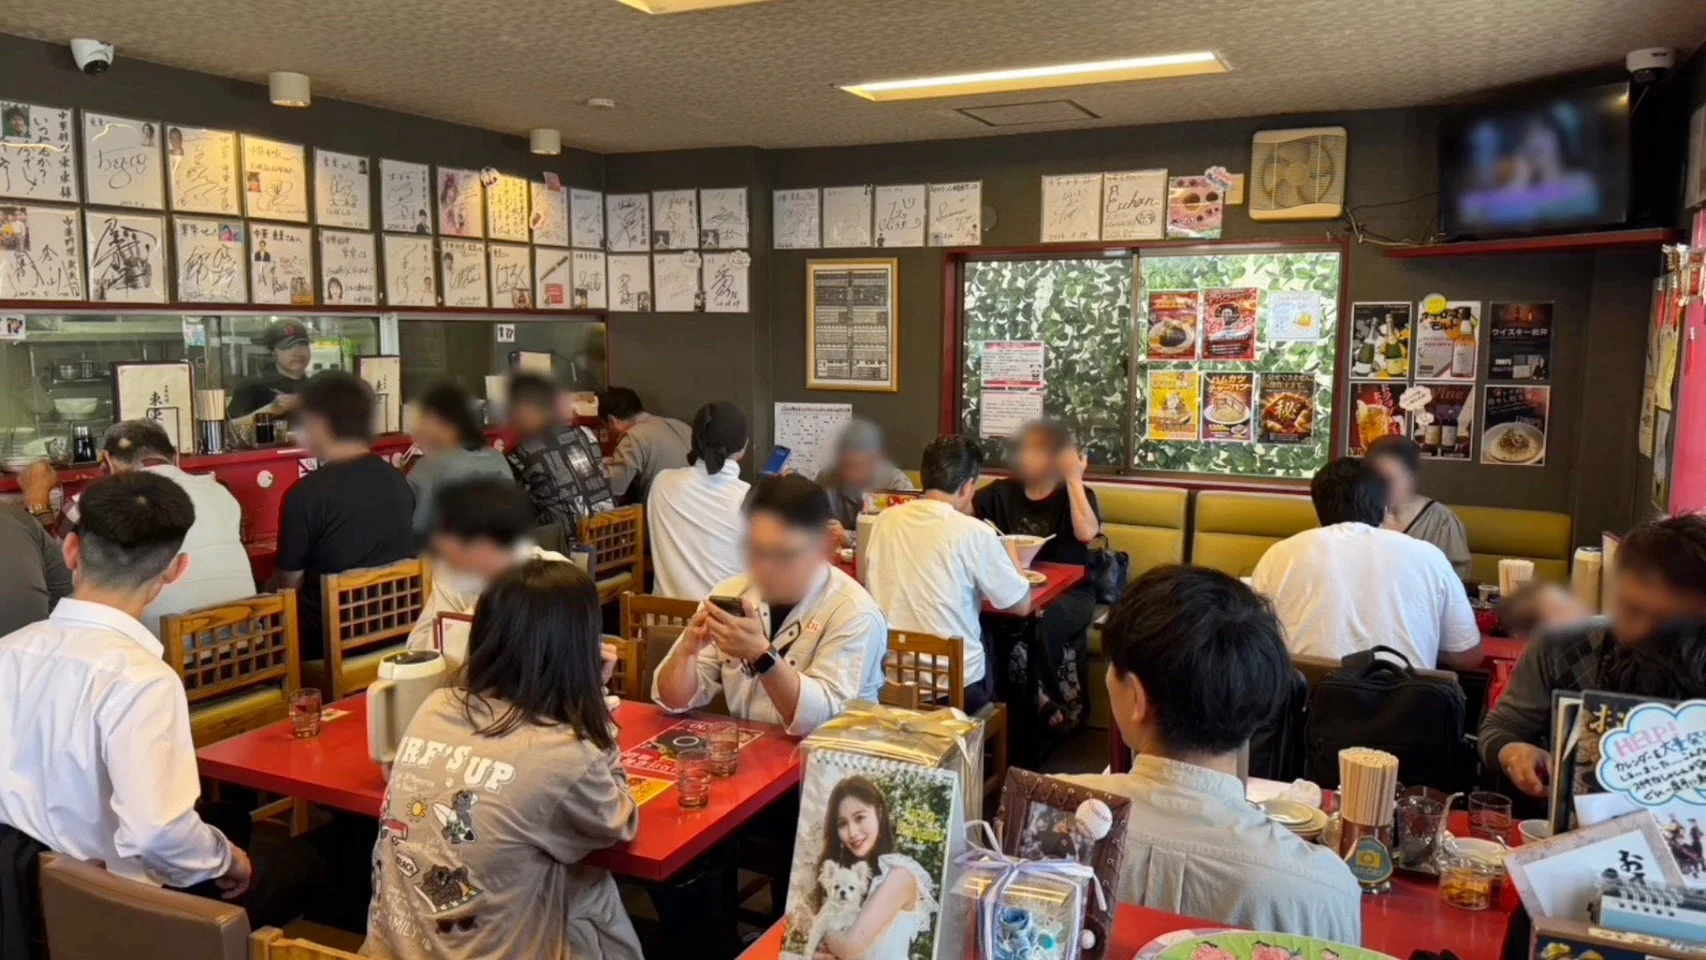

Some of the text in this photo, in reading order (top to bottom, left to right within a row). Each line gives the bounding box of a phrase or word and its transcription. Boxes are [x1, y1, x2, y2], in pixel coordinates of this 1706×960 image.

[1491, 327, 1549, 336] ウイスキー岩井
[1276, 399, 1297, 420] 秘
[1614, 719, 1680, 759] HELP!
[464, 756, 516, 794] UP
